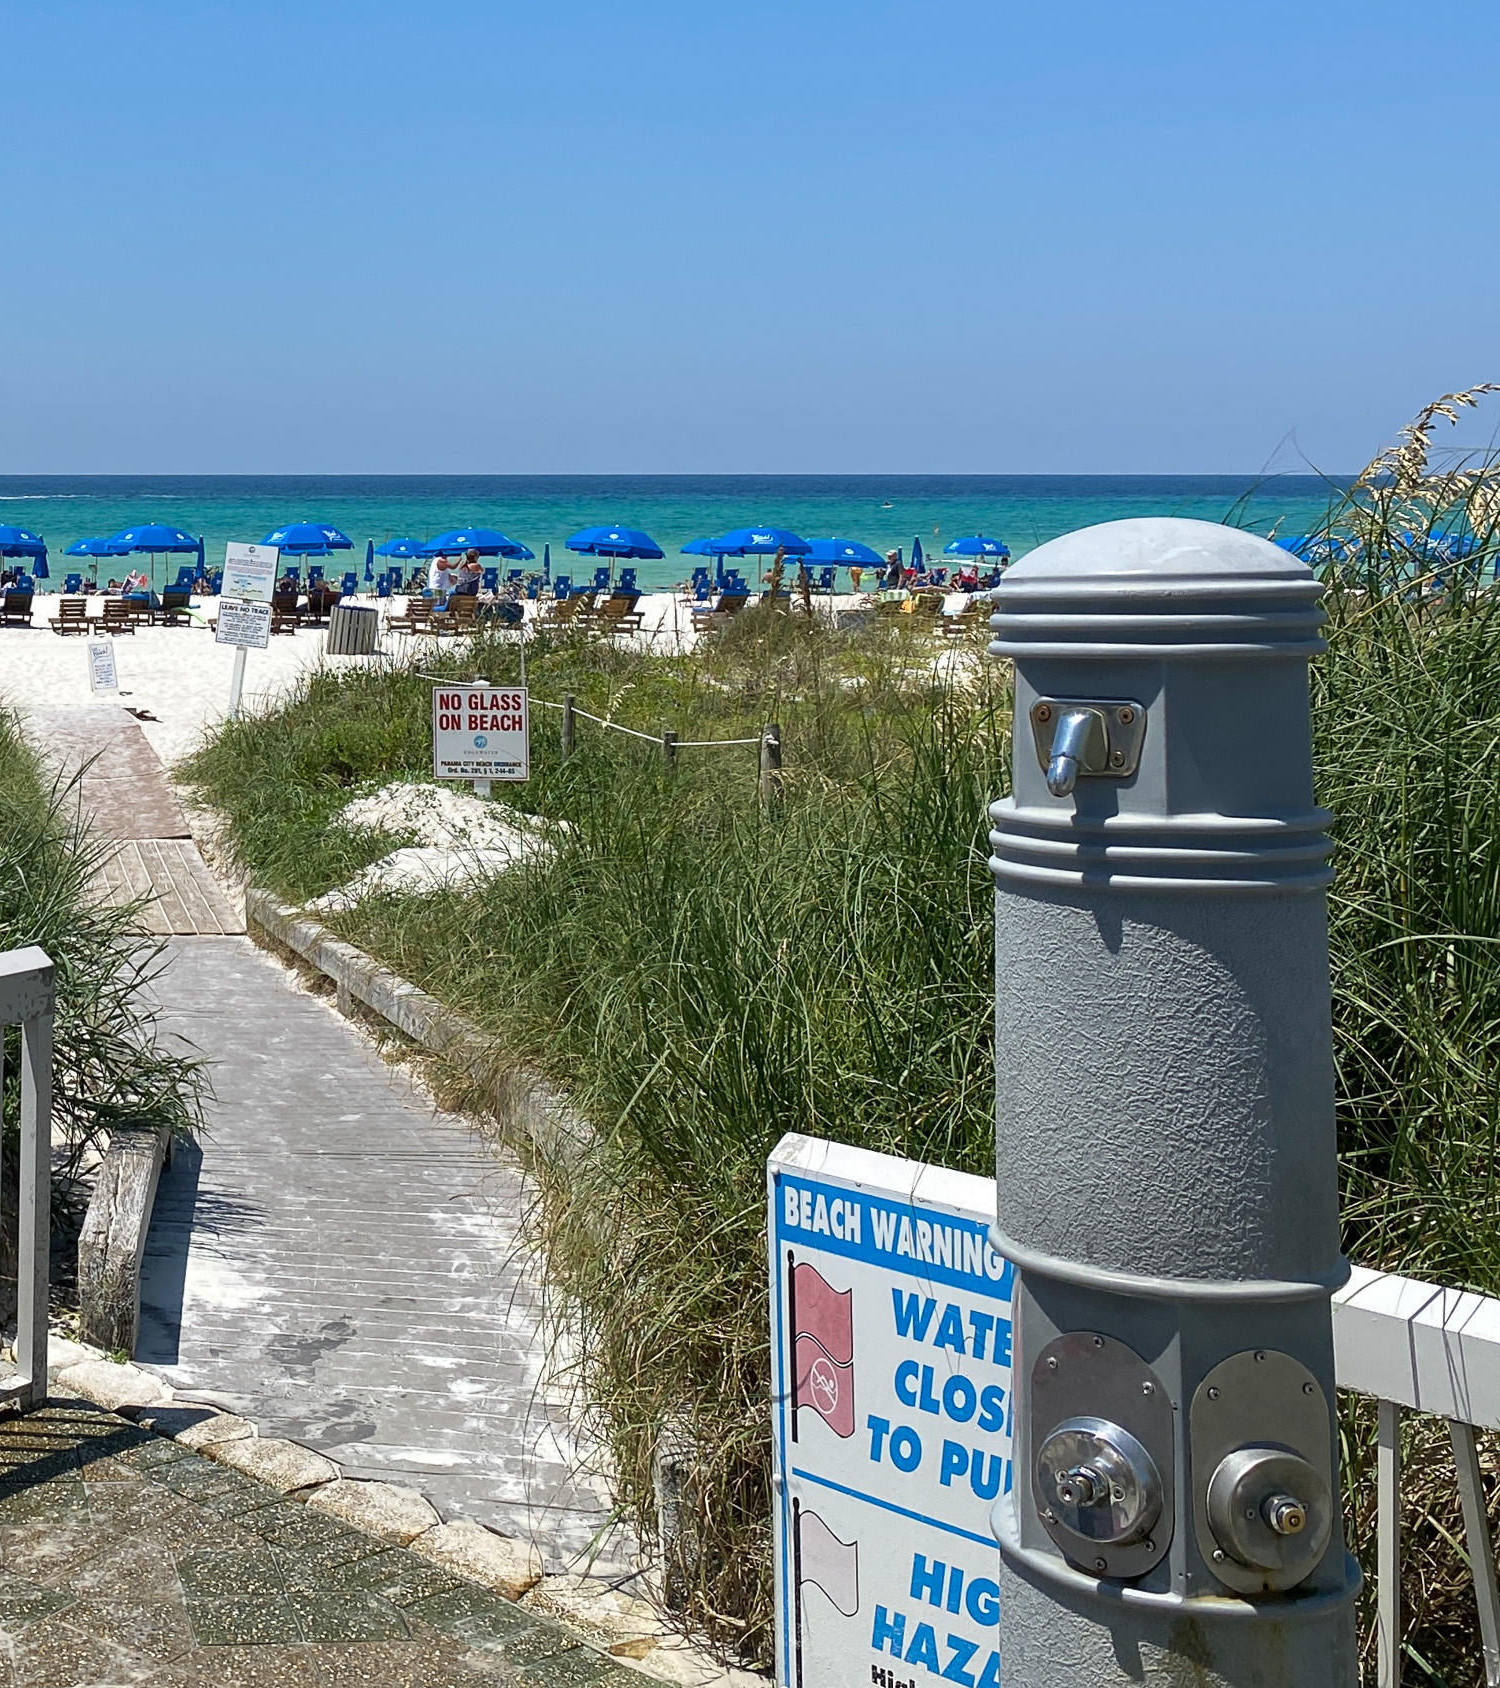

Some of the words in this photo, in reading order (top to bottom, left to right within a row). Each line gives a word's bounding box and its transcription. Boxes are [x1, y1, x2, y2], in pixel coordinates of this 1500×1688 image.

[251, 607, 270, 615] TRACE
[439, 693, 462, 711] NO
[468, 693, 522, 711] GLASS
[439, 714, 461, 731] ON
[468, 714, 523, 731] BEACH
[784, 1185, 862, 1244] BEACH
[870, 1207, 1005, 1282] WARNING
[894, 1359, 1013, 1438] CLOS
[866, 1414, 923, 1473] TO
[939, 1439, 1013, 1501] PU
